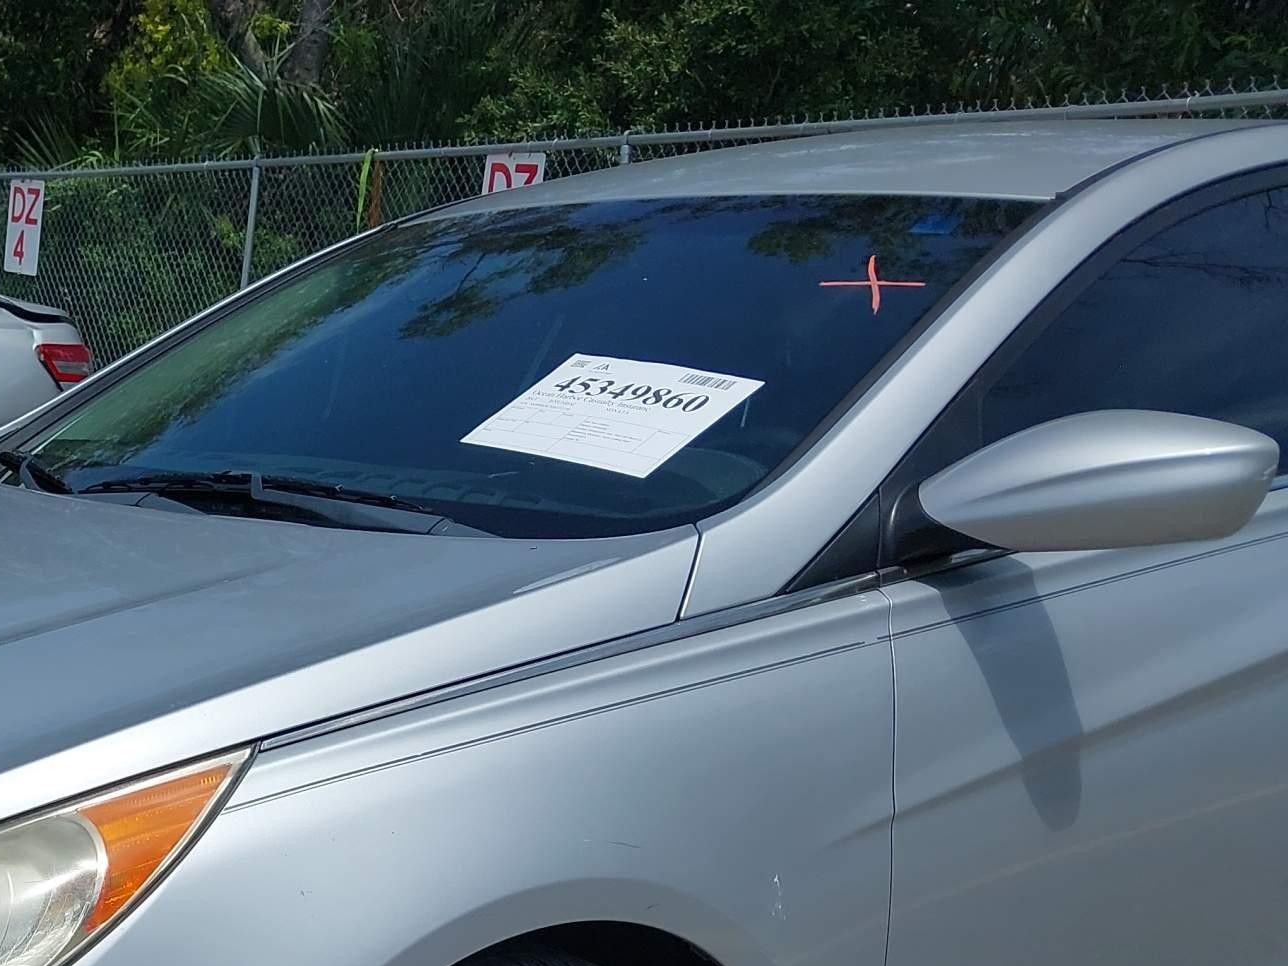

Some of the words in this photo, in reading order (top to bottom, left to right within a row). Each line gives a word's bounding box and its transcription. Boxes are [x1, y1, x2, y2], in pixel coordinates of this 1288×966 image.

[11, 186, 41, 225] DZ
[13, 230, 25, 265] 4
[554, 376, 710, 412] 45349860
